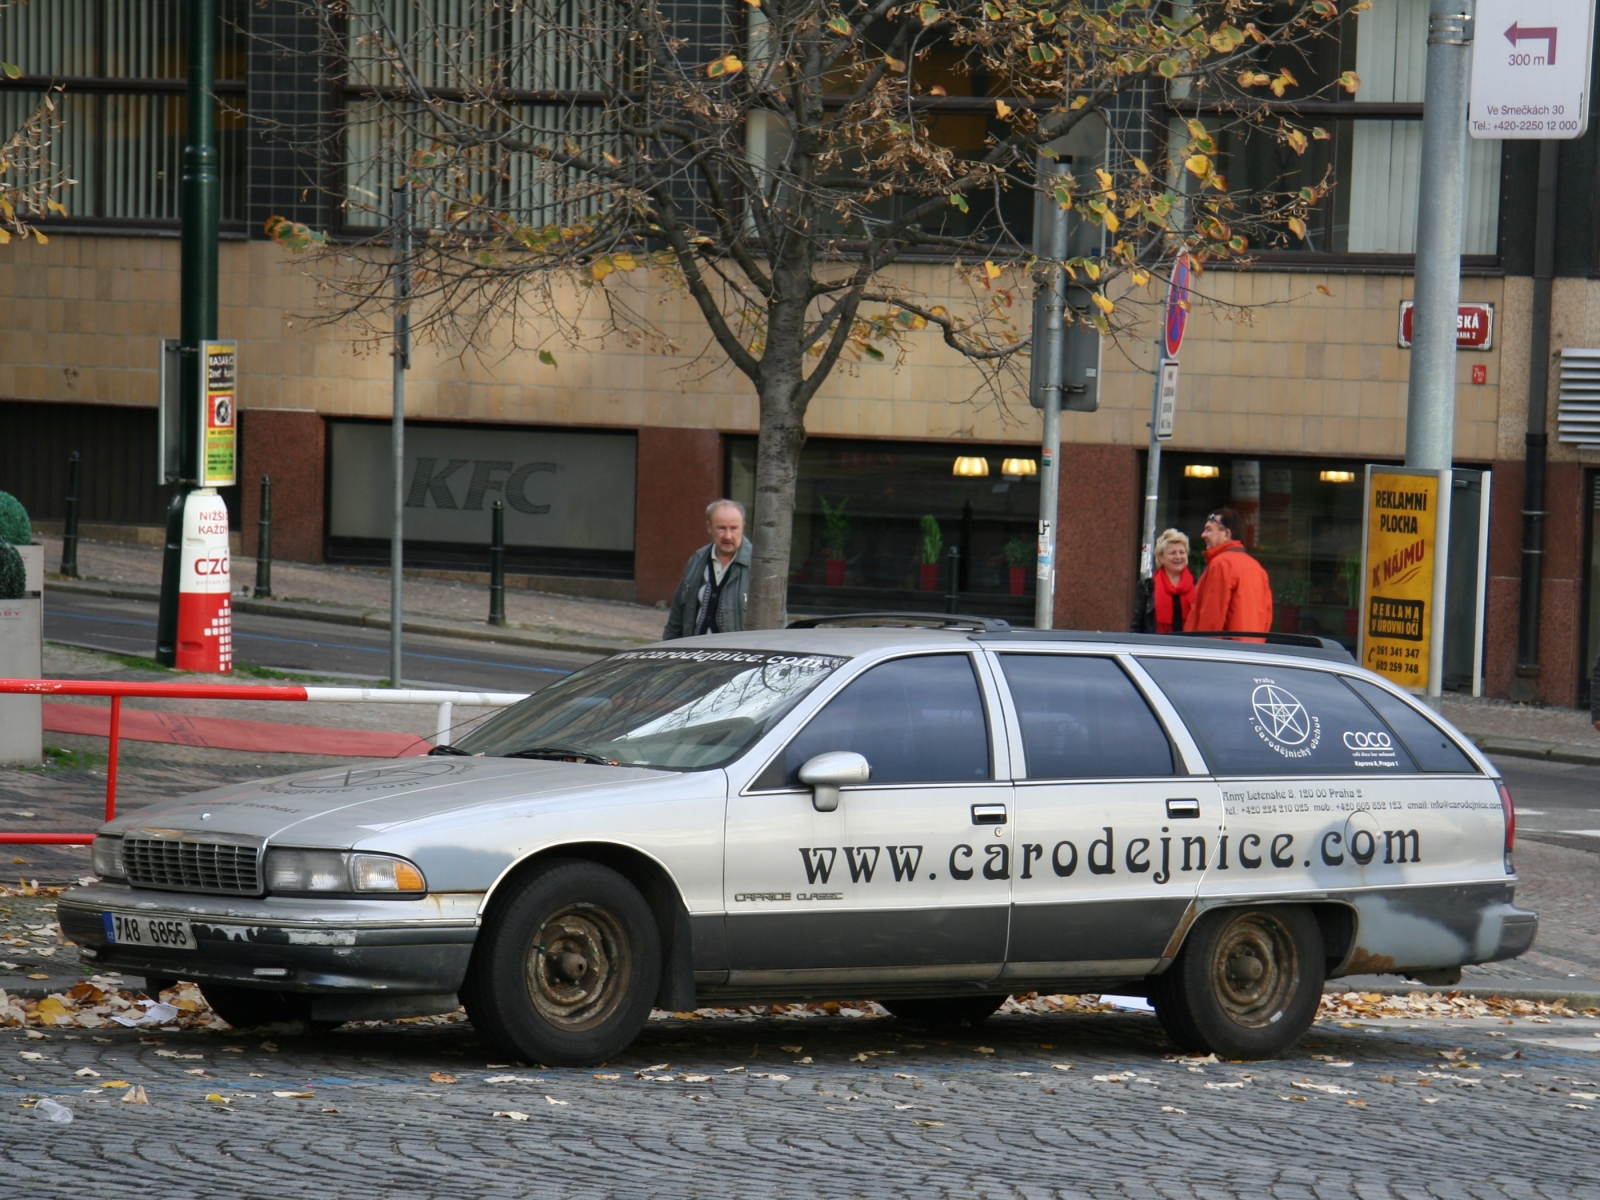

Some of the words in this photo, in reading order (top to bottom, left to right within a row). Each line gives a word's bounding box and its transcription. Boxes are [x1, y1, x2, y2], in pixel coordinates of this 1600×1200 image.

[1508, 54, 1531, 66] 300
[1533, 55, 1545, 66] m
[1487, 105, 1499, 115] Ve
[1501, 104, 1549, 115] Smečkách
[1552, 105, 1565, 115] 30
[1472, 121, 1491, 131] Tel.:
[1493, 121, 1544, 131] +420-2250
[1546, 121, 1556, 131] 12
[1559, 121, 1578, 130] 000
[403, 457, 558, 514] KFC
[1375, 489, 1428, 511] REKLAMNÍ
[1380, 514, 1418, 534] PLOCHA
[1372, 564, 1380, 589] K
[1383, 538, 1425, 582] NÁJMU
[1372, 603, 1420, 620] REKLAMA
[1371, 618, 1377, 632] V
[1377, 617, 1404, 634] ÚROVNI
[1405, 619, 1419, 636] OČÍ
[1376, 645, 1388, 655] 261
[1390, 646, 1402, 657] 341
[1405, 648, 1420, 658] 347
[1376, 660, 1387, 671] 602
[1389, 662, 1402, 672] 259
[1405, 663, 1419, 674] 748
[1253, 677, 1275, 685] Praha
[1310, 716, 1321, 750] obchod
[1343, 731, 1393, 750] COCO
[1222, 791, 1245, 802] Anny
[1247, 789, 1286, 800] Letenské
[1299, 789, 1314, 798] 120
[1315, 789, 1327, 798] 00
[1328, 789, 1355, 798] Praha
[1355, 789, 1362, 798] 2
[1240, 804, 1260, 814] +420
[1262, 804, 1277, 813] 224
[1279, 804, 1293, 813] 210
[1335, 802, 1355, 811] +420
[1356, 802, 1370, 811] 605
[1372, 801, 1386, 810] 852
[799, 826, 1423, 885] www.carodejnice.com
[734, 892, 791, 902] CAPRICE
[796, 892, 843, 901] CLASSIC
[107, 931, 114, 939] CZ
[115, 916, 140, 942] 7A8
[148, 920, 187, 945] 6855
